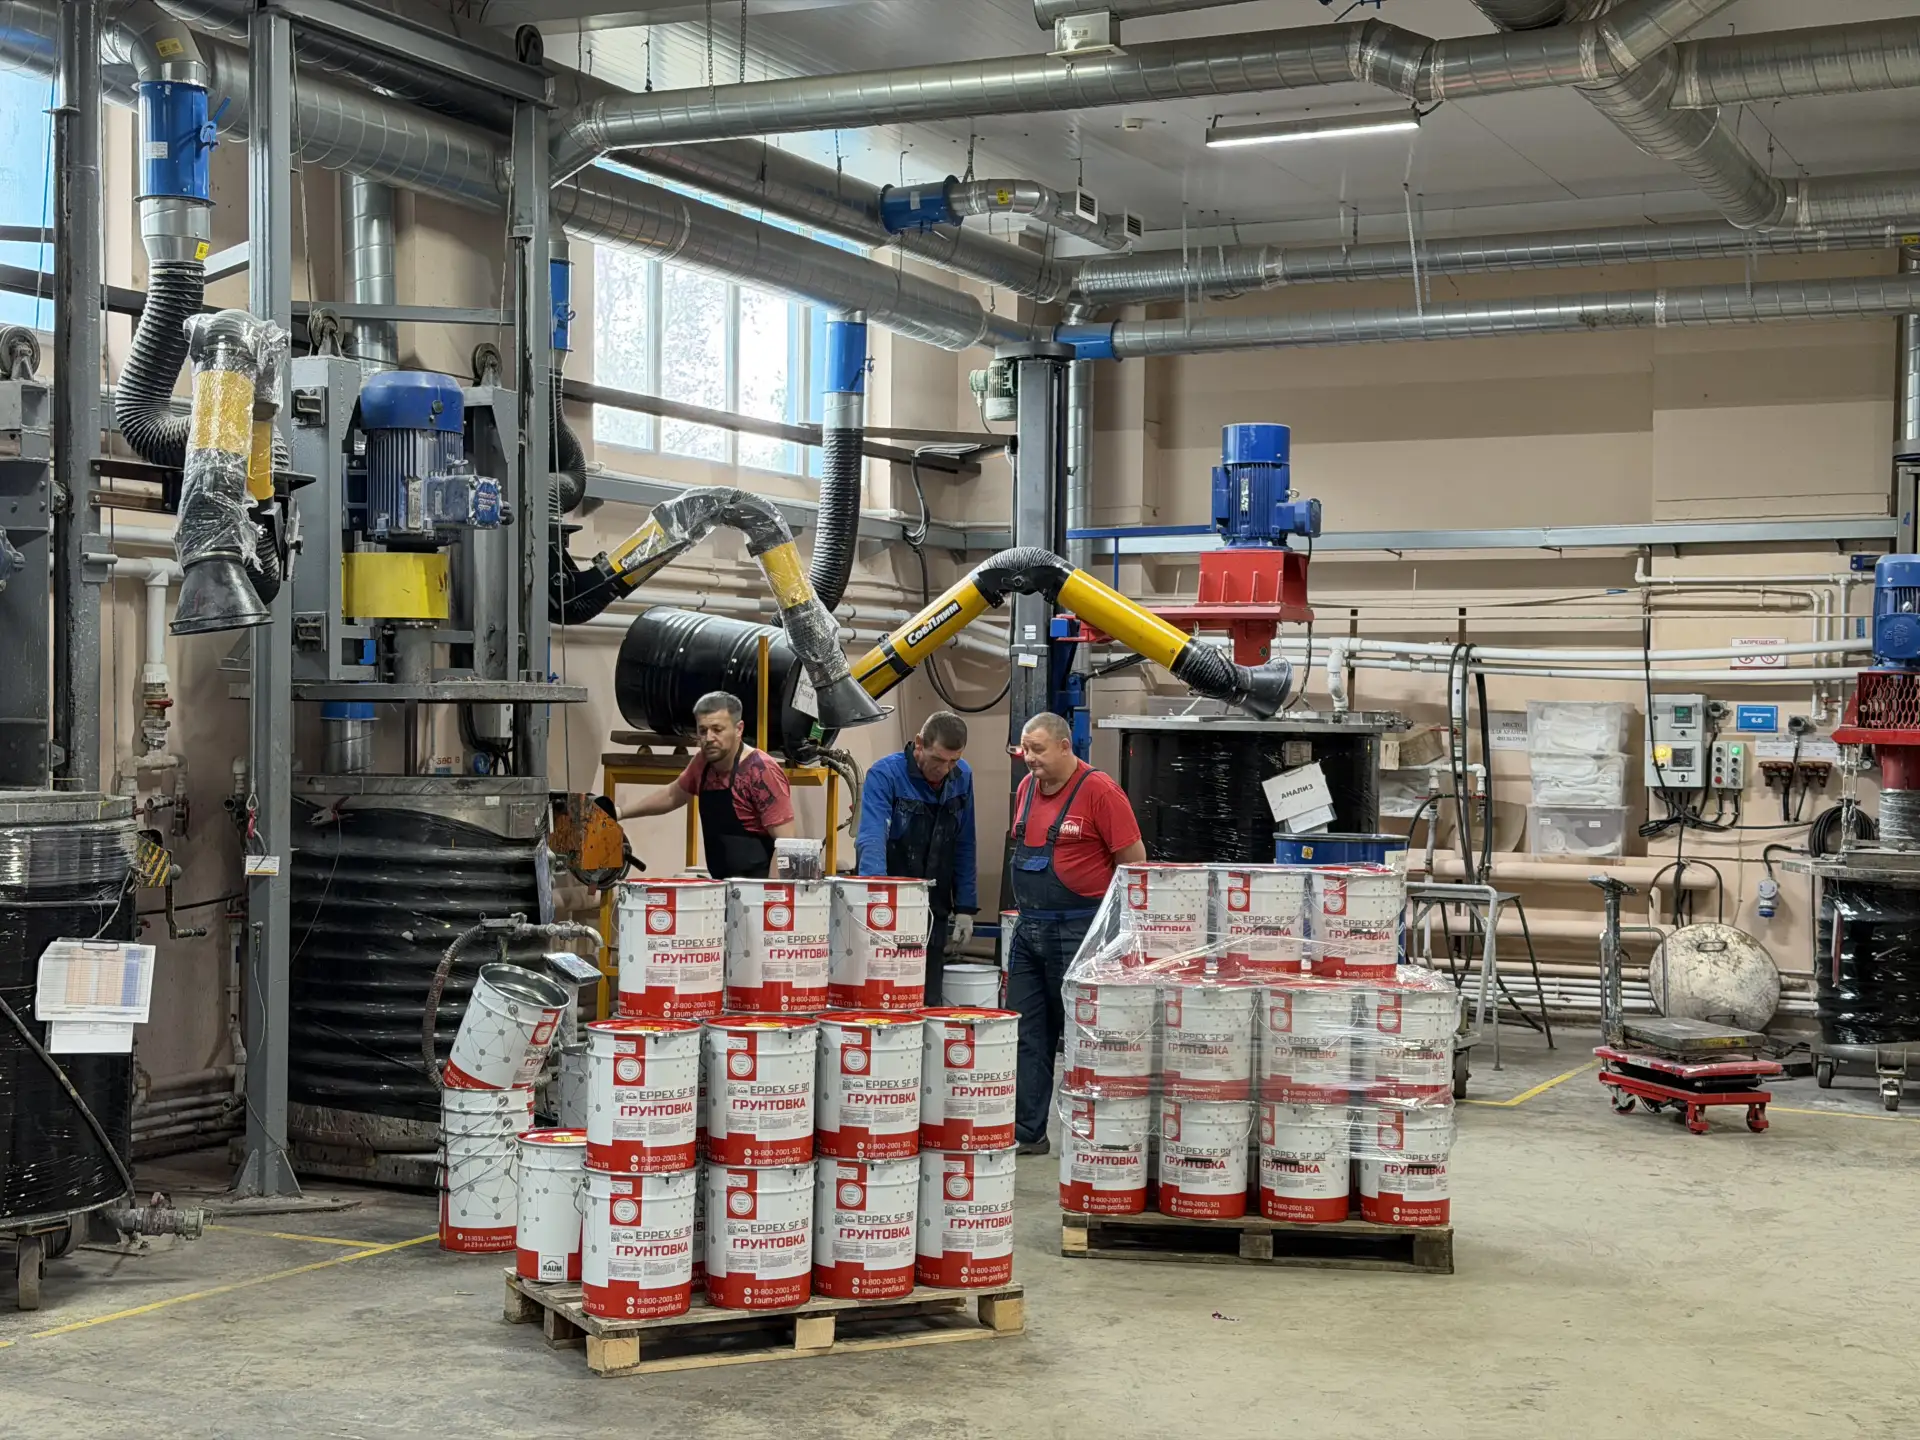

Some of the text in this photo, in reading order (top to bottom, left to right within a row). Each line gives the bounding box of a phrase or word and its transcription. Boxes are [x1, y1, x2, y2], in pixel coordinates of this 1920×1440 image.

[1281, 783, 1314, 799] АНАЛИЗ
[1187, 913, 1196, 921] 90
[1243, 915, 1272, 923] EPPEX
[1274, 915, 1285, 923] SF
[1343, 919, 1373, 927] EPPEX
[671, 938, 704, 948] EPPEX
[706, 937, 716, 947] SF
[787, 935, 817, 944] EPPEX
[653, 952, 720, 964] ГРУНТОВКА
[1178, 1032, 1206, 1040] EPPEX
[1289, 1036, 1318, 1045] EPPEX
[970, 1073, 1001, 1081] EPPEX
[1002, 1072, 1011, 1080] SF
[750, 1082, 810, 1094] EPPEX SF 90
[865, 1080, 899, 1089] EPPEX
[902, 1079, 913, 1087] SF
[640, 1086, 696, 1100] EPPEX SF 90
[952, 1084, 1015, 1097] ГРУНТОВКА
[847, 1092, 916, 1105] ГРУНТОВКА
[620, 1101, 693, 1117] ГРУНТОВКА
[732, 1098, 806, 1111] ГРУНТОВКА
[867, 1140, 911, 1149] 8-800-2001-321
[754, 1147, 801, 1156] 8-800-2001-321
[866, 1149, 910, 1158] raum-profie.ru
[1175, 1146, 1204, 1155] EPPEX
[1206, 1148, 1218, 1156] SF
[1270, 1149, 1297, 1159] EPPEX
[1300, 1152, 1312, 1160] SF
[641, 1153, 687, 1163] 8-800-2001-321
[754, 1156, 800, 1165] raum-profie.ru
[1076, 1153, 1139, 1166] ГРУНТОВКА
[640, 1163, 686, 1172] raum-profie.ru
[1262, 1159, 1321, 1174] ГРУНТОВКА
[968, 1202, 1009, 1214] EPPEX SF
[857, 1211, 914, 1224] EPPEX SF 90
[1273, 1210, 1314, 1219] raum-profie.ru
[751, 1217, 809, 1233] EPPEX SF 90
[636, 1225, 692, 1240] EPPEX SF 90
[839, 1226, 911, 1240] ГРУНТОВКА
[732, 1234, 806, 1249] ГРУНТОВКА
[616, 1242, 689, 1257] ГРУНТОВКА
[543, 1264, 562, 1272] RAUM
[862, 1276, 906, 1285] 8-800-2001-321
[754, 1285, 801, 1295] 8-800-2001-321
[861, 1285, 905, 1294] raum-profie.ru
[637, 1294, 683, 1304] 8-800-2001-321
[754, 1295, 800, 1304] raum-profie.ru
[636, 1303, 682, 1315] raum-profie.ru
